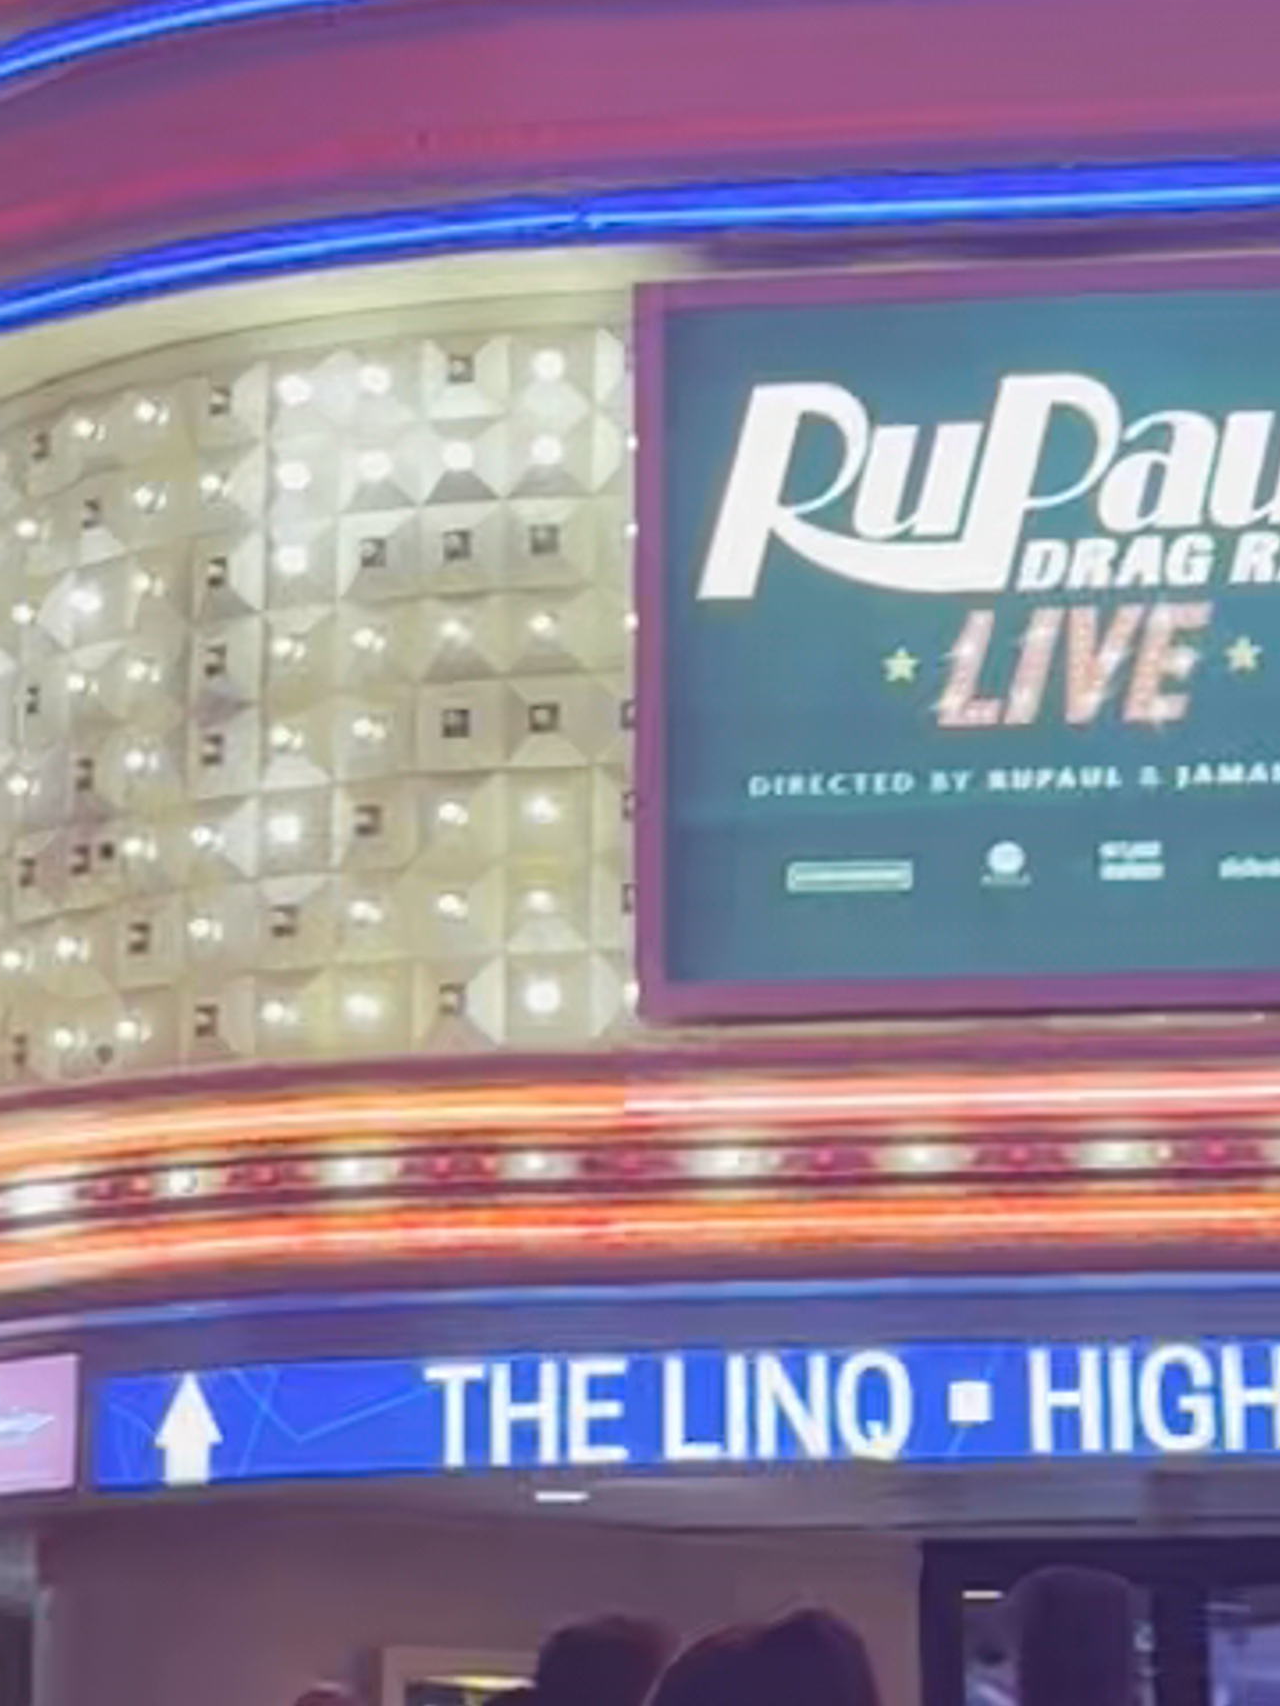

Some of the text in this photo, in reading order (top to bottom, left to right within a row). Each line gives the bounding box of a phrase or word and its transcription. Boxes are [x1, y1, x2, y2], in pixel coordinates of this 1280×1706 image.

[1016, 537, 1215, 591] DRAG
[934, 600, 1214, 727] LIVE
[748, 770, 915, 797] DIRECTED
[930, 769, 971, 794] BY
[987, 765, 1122, 792] RUPAUL
[423, 1355, 629, 1468] THE
[662, 1349, 913, 1461] LINQ
